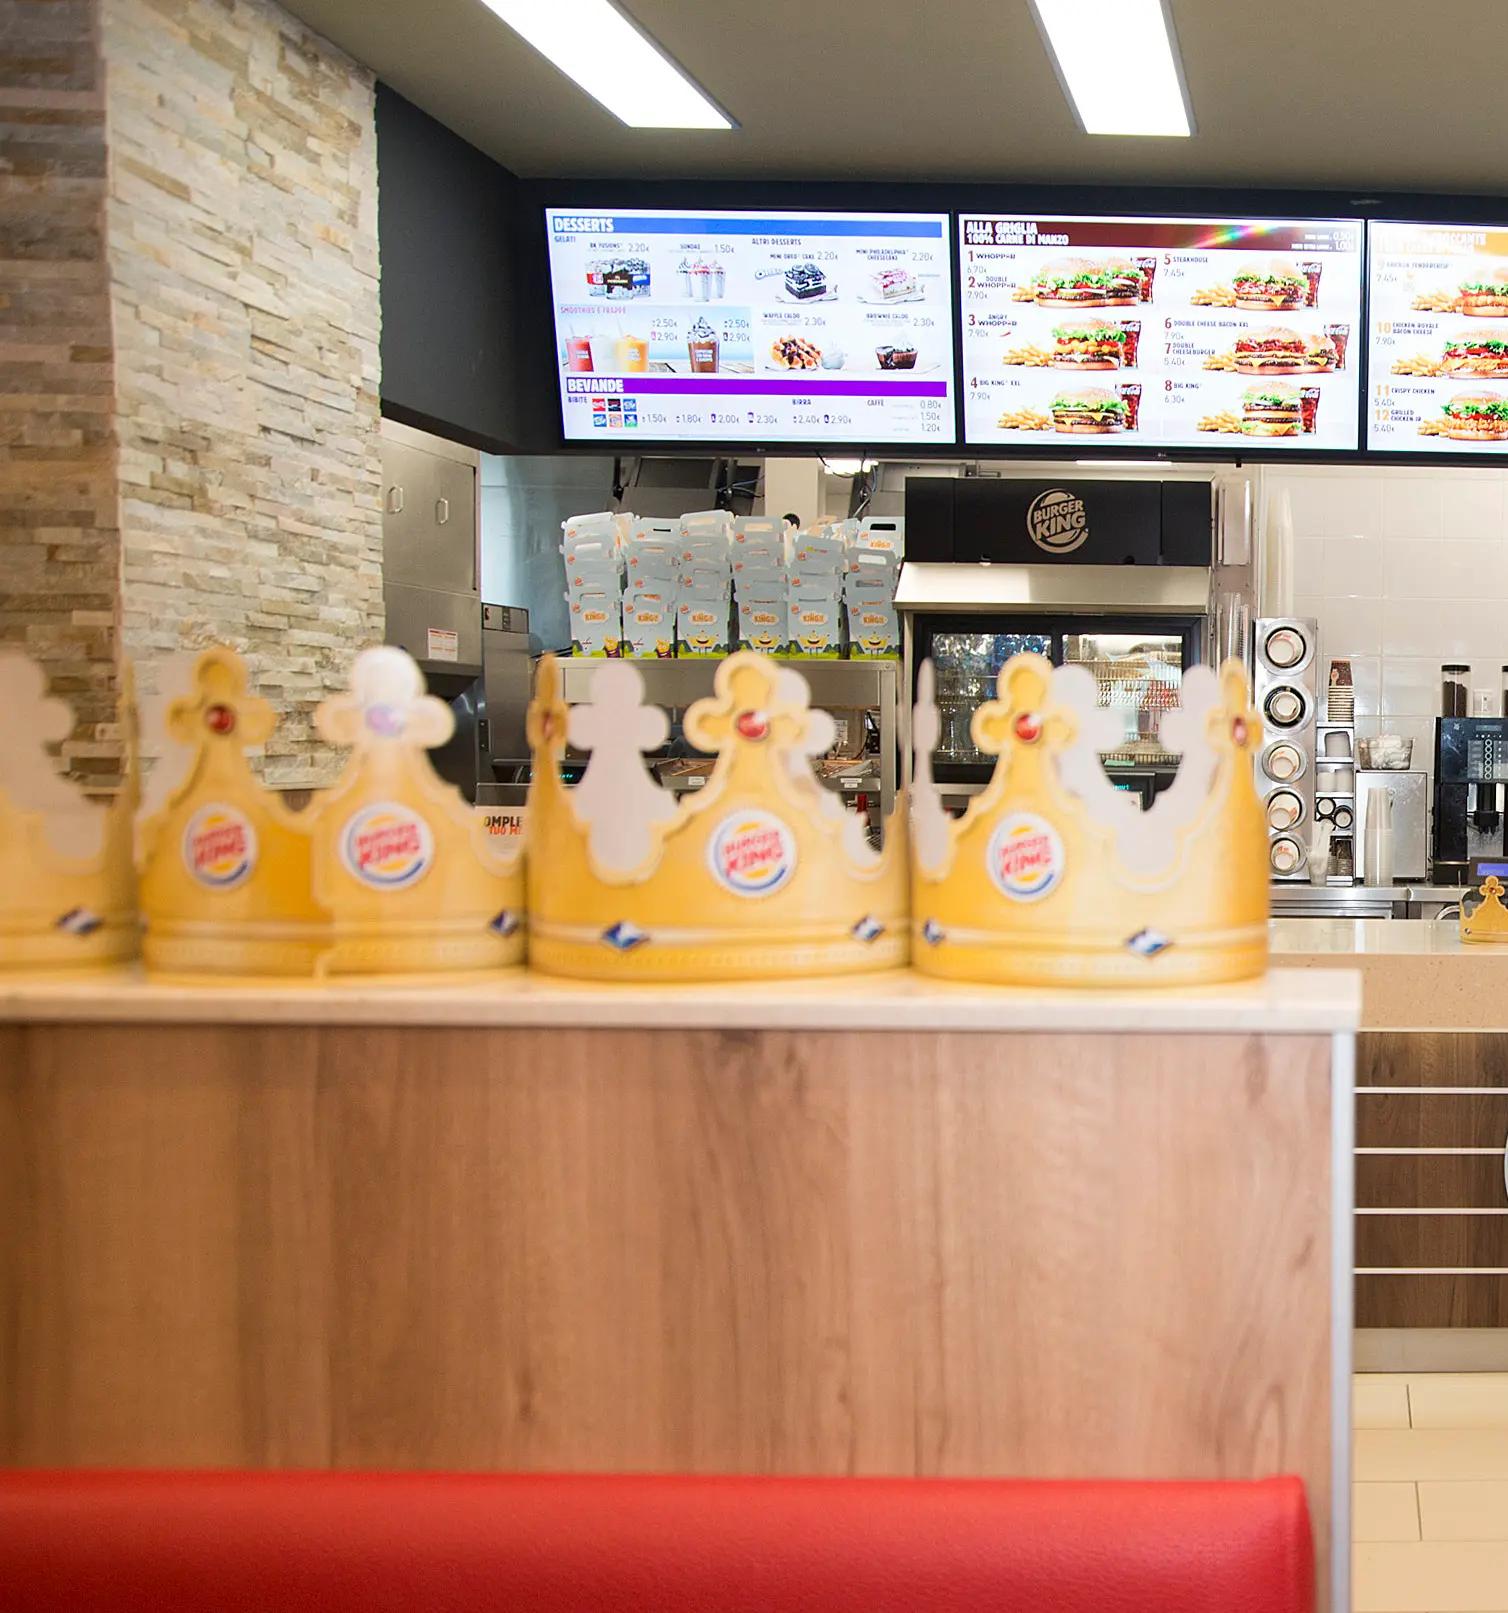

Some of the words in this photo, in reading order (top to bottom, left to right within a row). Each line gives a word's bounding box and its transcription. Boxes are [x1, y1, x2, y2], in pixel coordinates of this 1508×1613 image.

[554, 217, 614, 232] DESSERTS
[966, 222, 994, 234] ALLA
[995, 222, 1038, 234] GRIGLIA
[771, 238, 802, 246] DESSERTS
[966, 234, 994, 244] 100%
[995, 234, 1024, 244] CARNE
[1026, 234, 1036, 244] DI
[714, 244, 735, 254] 1.50€
[817, 251, 838, 261] 2.20€
[912, 252, 934, 262] 2.20€
[1164, 254, 1171, 265] 5
[968, 276, 976, 288] 2
[804, 316, 826, 326] 2.30€
[913, 318, 935, 328] 2.30€
[968, 314, 976, 326] 3
[1164, 318, 1172, 329] 6
[1378, 322, 1391, 334] 10
[1164, 342, 1172, 354] 7
[567, 378, 624, 393] BEVANDE
[970, 377, 978, 388] 4
[1165, 380, 1172, 391] 8
[1376, 384, 1390, 396] 11
[1376, 409, 1390, 421] 12
[1033, 500, 1084, 523] BURGER
[1034, 512, 1086, 541] KING
